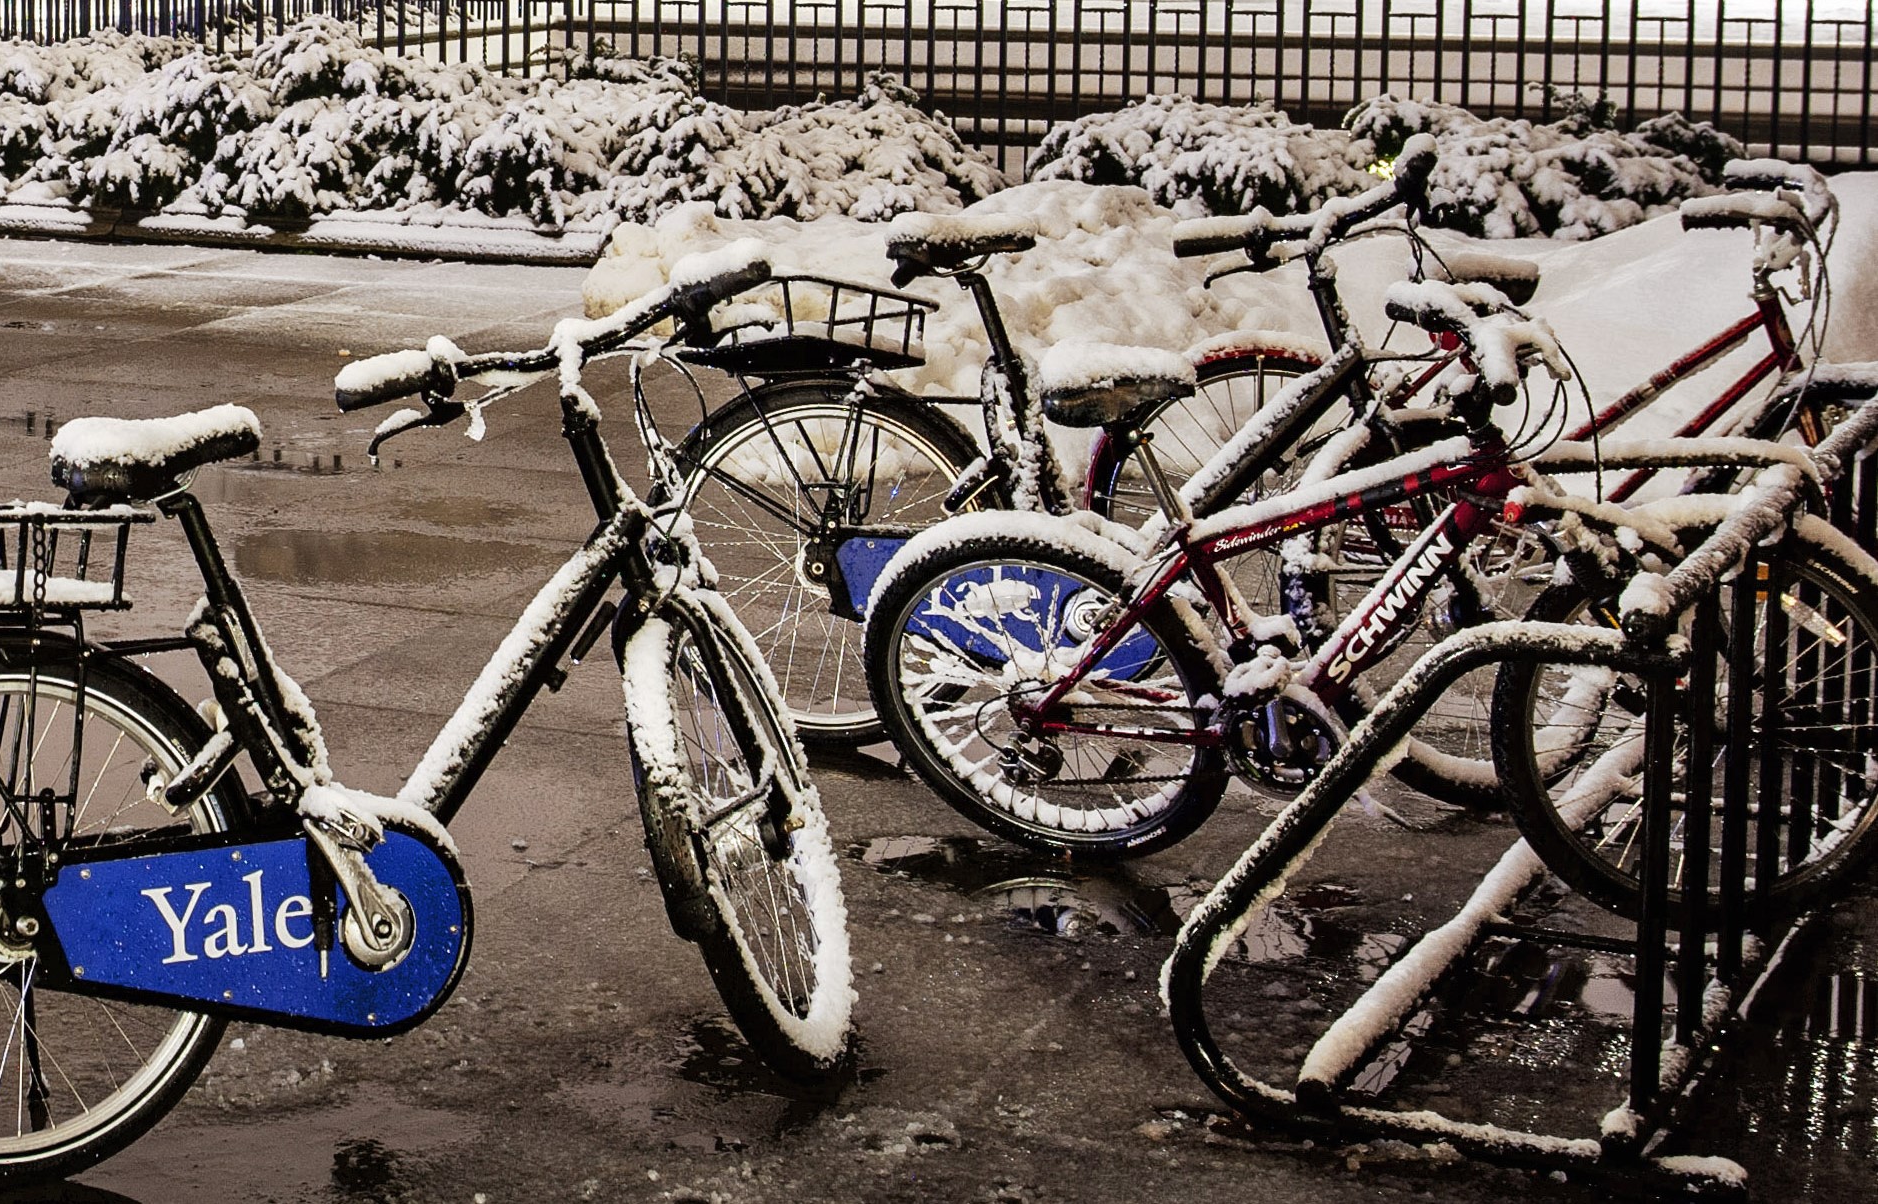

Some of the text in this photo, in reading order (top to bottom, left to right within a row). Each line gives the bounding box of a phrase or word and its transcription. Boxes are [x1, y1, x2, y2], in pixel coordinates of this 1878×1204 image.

[1214, 525, 1282, 552] Sidewinder
[1328, 532, 1454, 684] SCHWINN
[1813, 562, 1859, 594] SCHWINN
[141, 870, 314, 964] Yale
